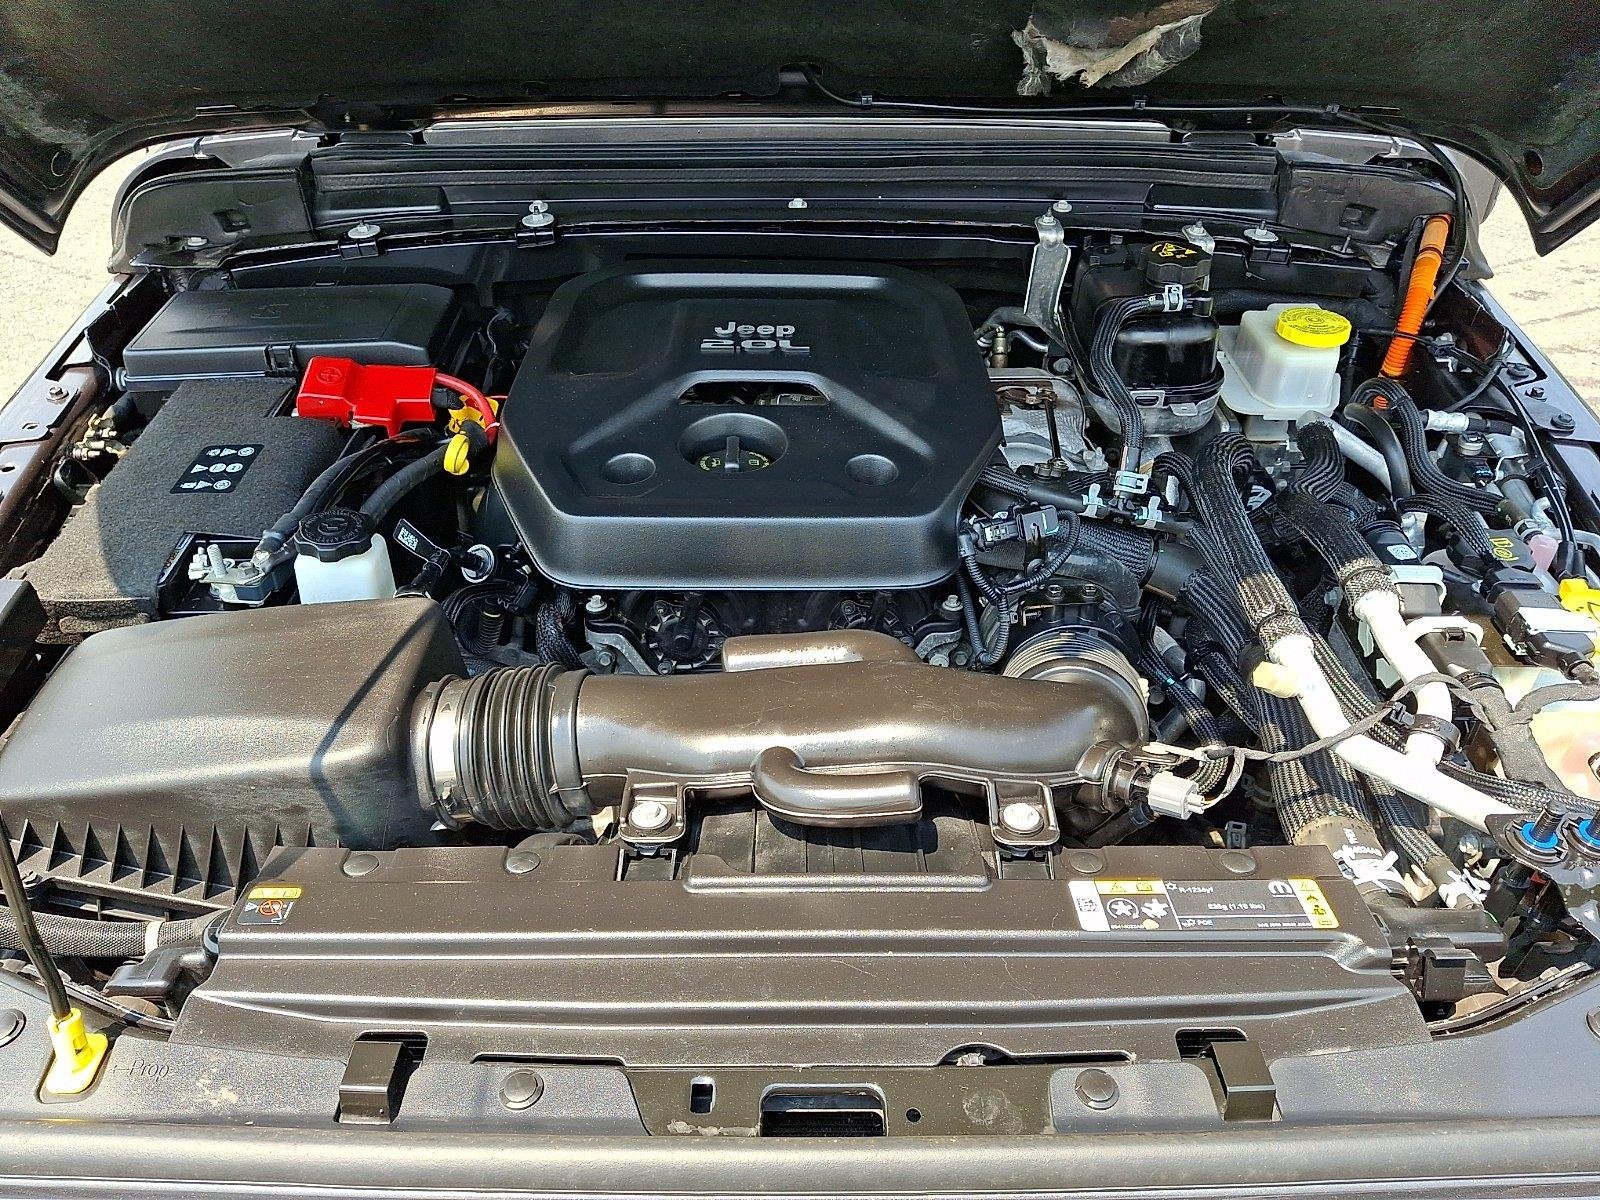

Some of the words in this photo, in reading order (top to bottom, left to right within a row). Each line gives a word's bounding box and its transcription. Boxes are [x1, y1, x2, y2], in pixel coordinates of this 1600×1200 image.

[714, 321, 796, 338] Jeep
[701, 339, 810, 353] 2.0L
[129, 1059, 170, 1082] Prop
